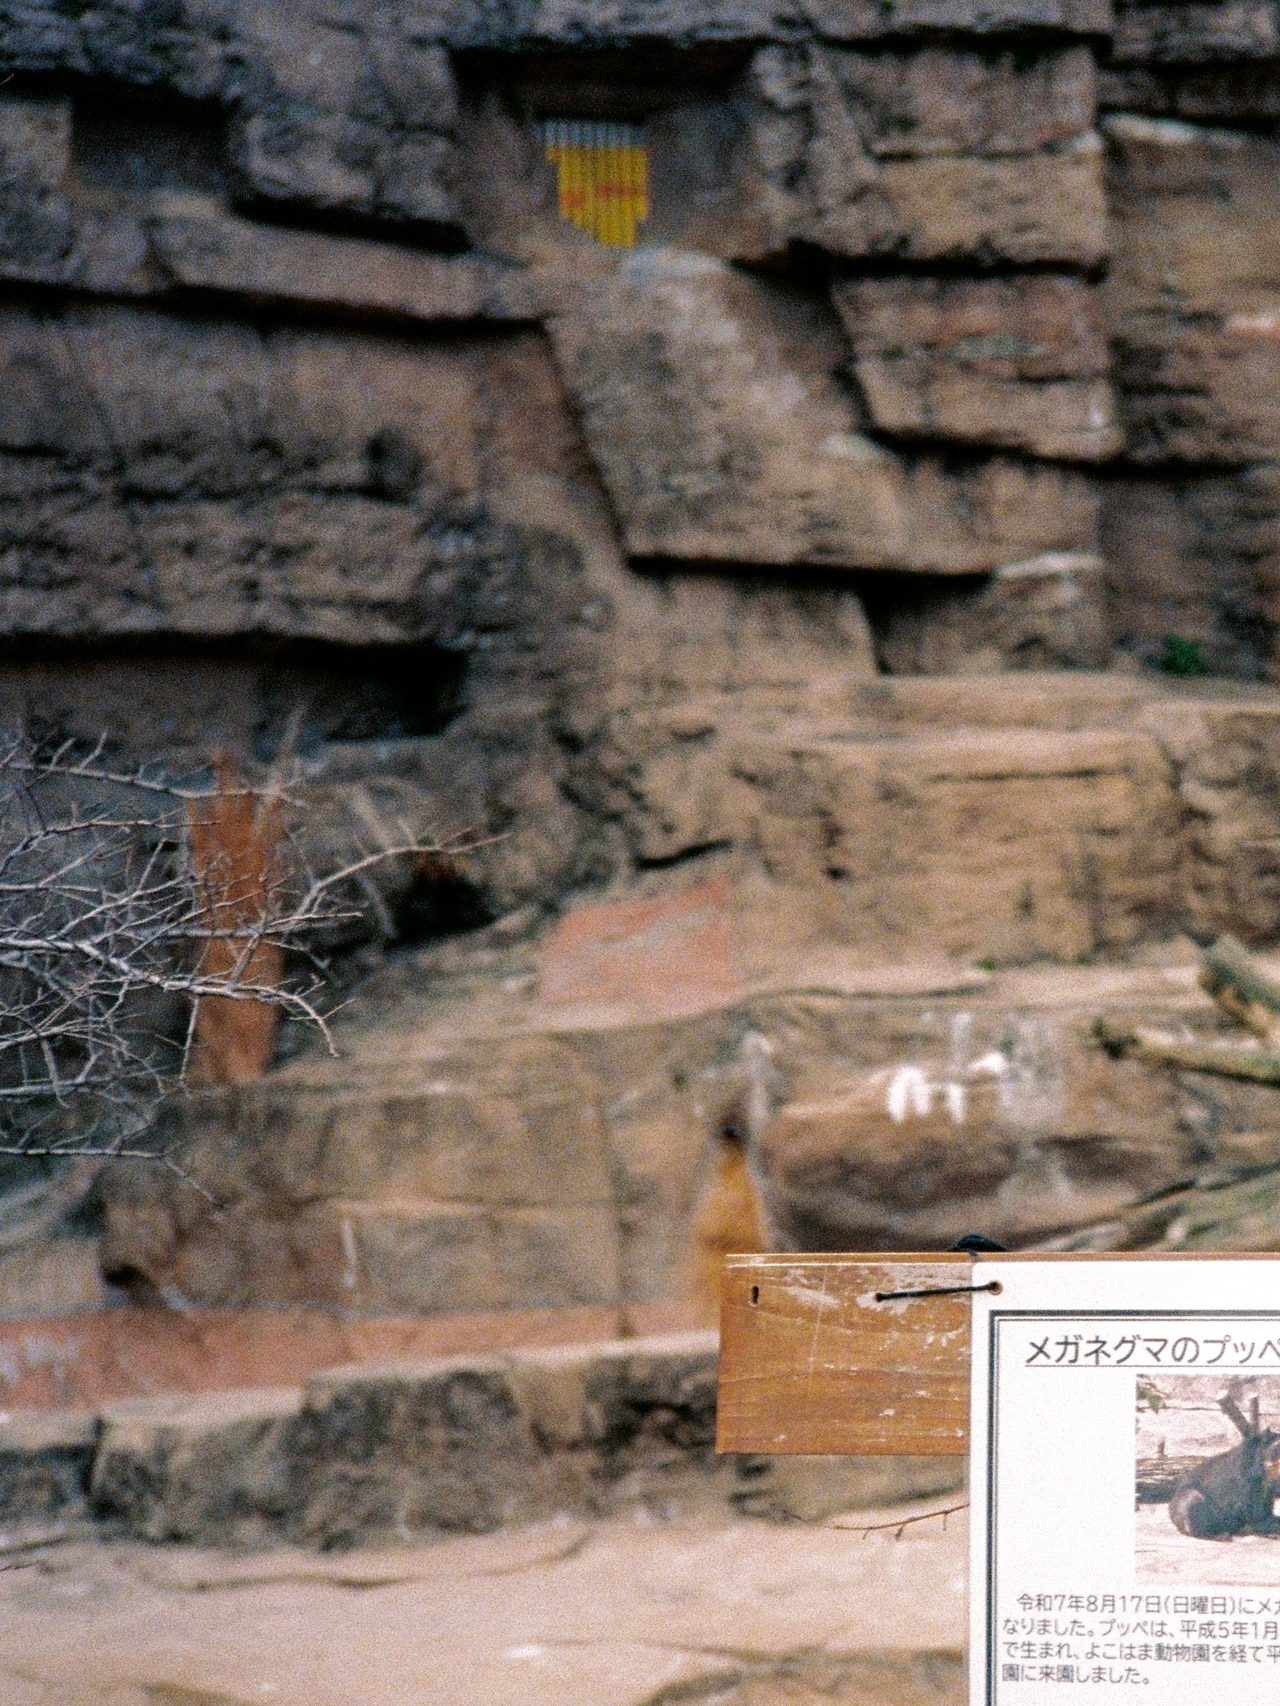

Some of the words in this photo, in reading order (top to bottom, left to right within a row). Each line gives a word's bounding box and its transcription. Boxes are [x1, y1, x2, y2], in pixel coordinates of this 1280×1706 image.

[1001, 1664, 1151, 1685] 園に来園しました。
